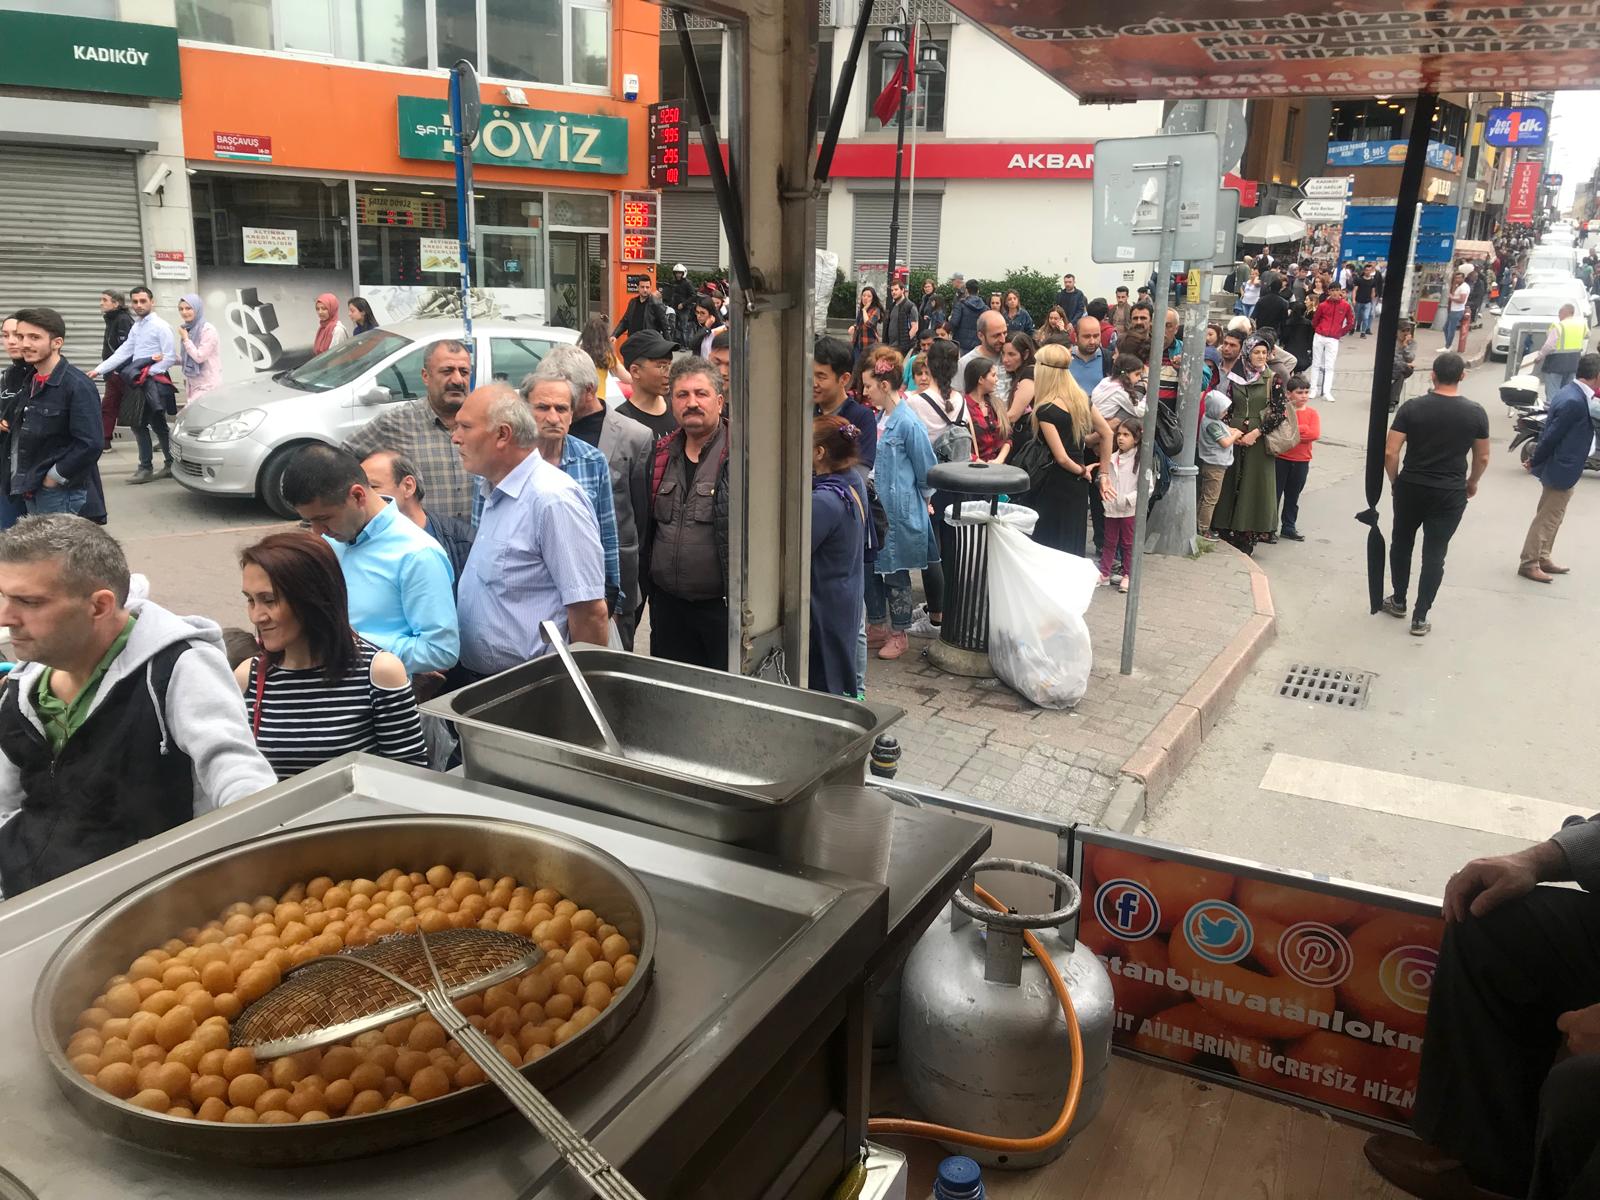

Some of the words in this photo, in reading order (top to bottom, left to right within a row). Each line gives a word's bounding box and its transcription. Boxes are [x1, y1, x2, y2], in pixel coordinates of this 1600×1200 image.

[1011, 25, 1118, 41] ÖZEL
[1119, 8, 1451, 37] GÜNLERİNİZDE
[1463, 1, 1600, 21] MEVL
[73, 45, 149, 66] KADIKÖY
[1207, 47, 1274, 61] İLE
[1102, 77, 1198, 87] 0544
[1209, 73, 1287, 85] 942
[1302, 71, 1354, 83] 14
[1367, 69, 1424, 81] 06
[1470, 64, 1589, 77] 0539
[415, 124, 456, 137] ŞATI
[1495, 119, 1510, 128] her
[1506, 111, 1522, 142] 1
[1518, 119, 1543, 132] dk.
[216, 135, 259, 148] BAŞÇAVUŞ
[1113, 1007, 1135, 1031] İT
[1138, 1016, 1253, 1063] AİLELERİNE
[1258, 1044, 1358, 1093] ÜCRETSİZ
